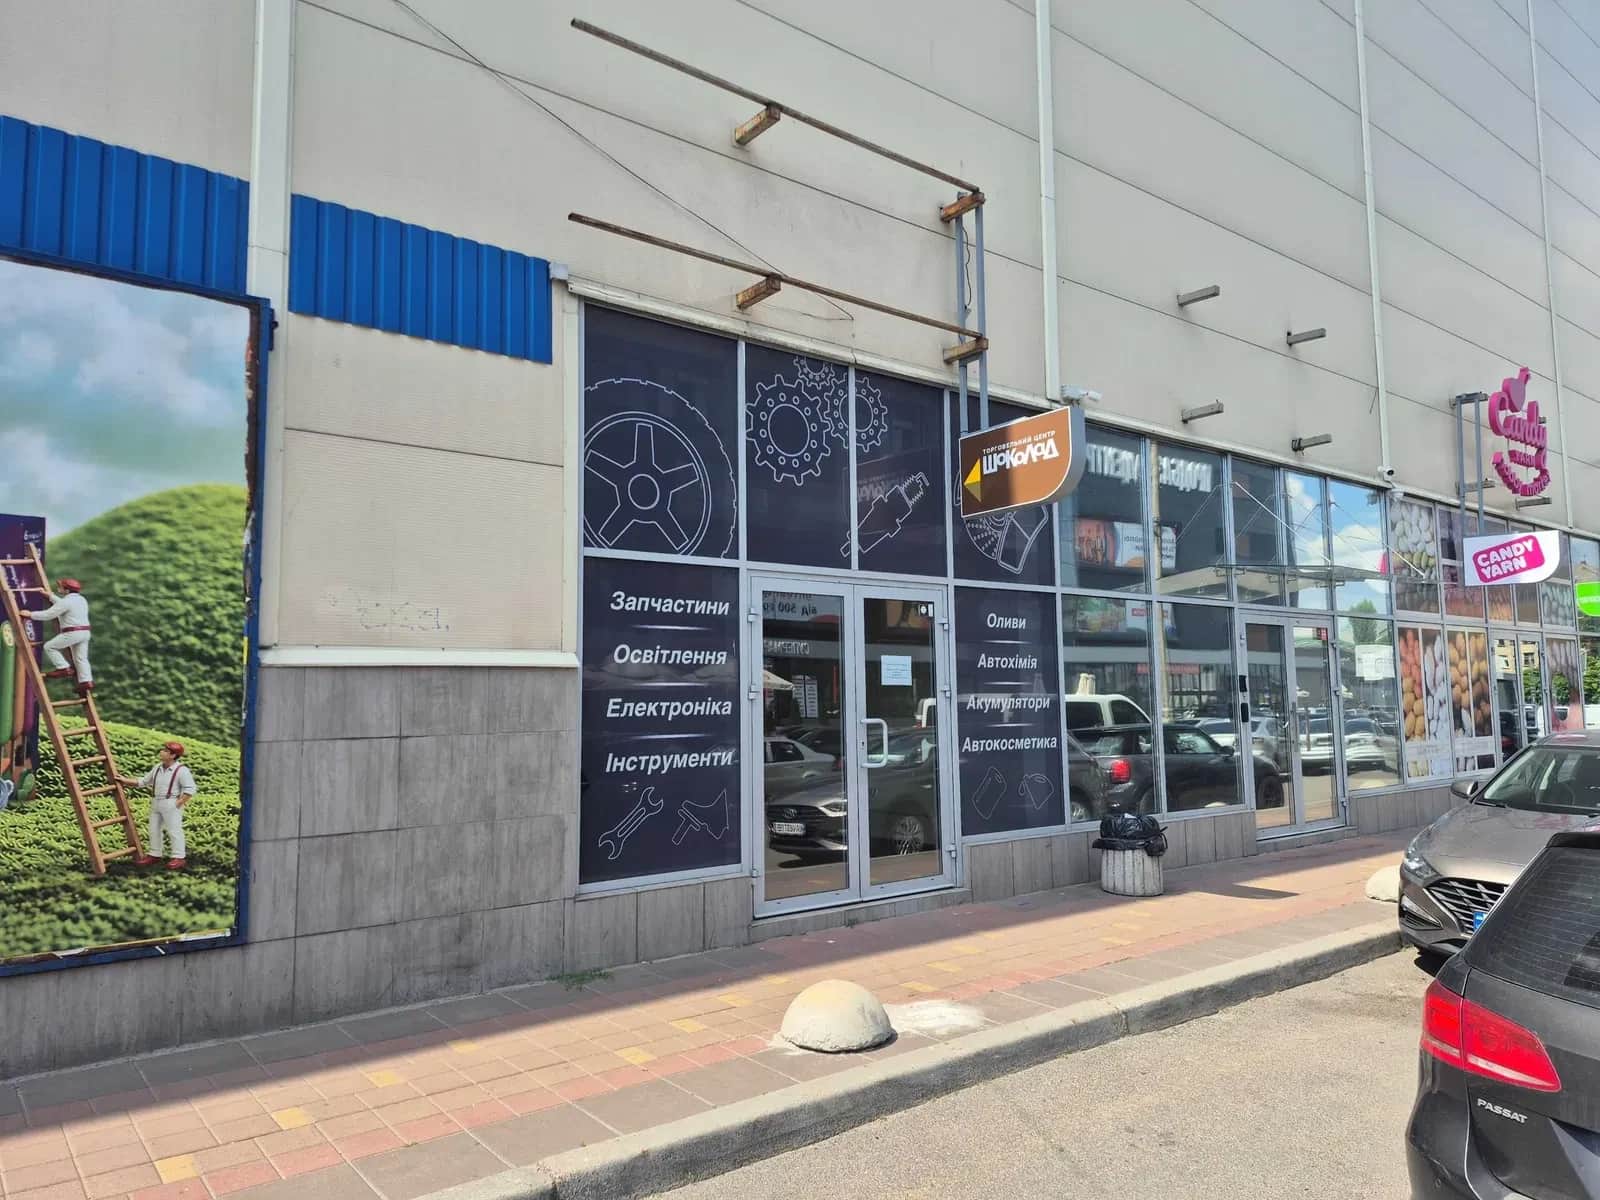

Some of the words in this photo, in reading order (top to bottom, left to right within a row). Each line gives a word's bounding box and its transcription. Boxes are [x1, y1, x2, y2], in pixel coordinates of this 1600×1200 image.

[1034, 430, 1056, 441] ЦЕНТР
[1477, 539, 1534, 567] CANDY
[1480, 556, 1527, 579] YARN
[610, 591, 730, 615] Запчастини
[986, 612, 1027, 629] Оливи
[613, 644, 728, 665] Освітлення
[977, 653, 1038, 669] Автохімія
[606, 697, 732, 720] Електроніка
[966, 694, 1051, 713] Акумулятори
[962, 736, 1057, 753] Автокосметика
[605, 750, 733, 775] Інструменти
[1477, 1098, 1528, 1123] PASSAT
